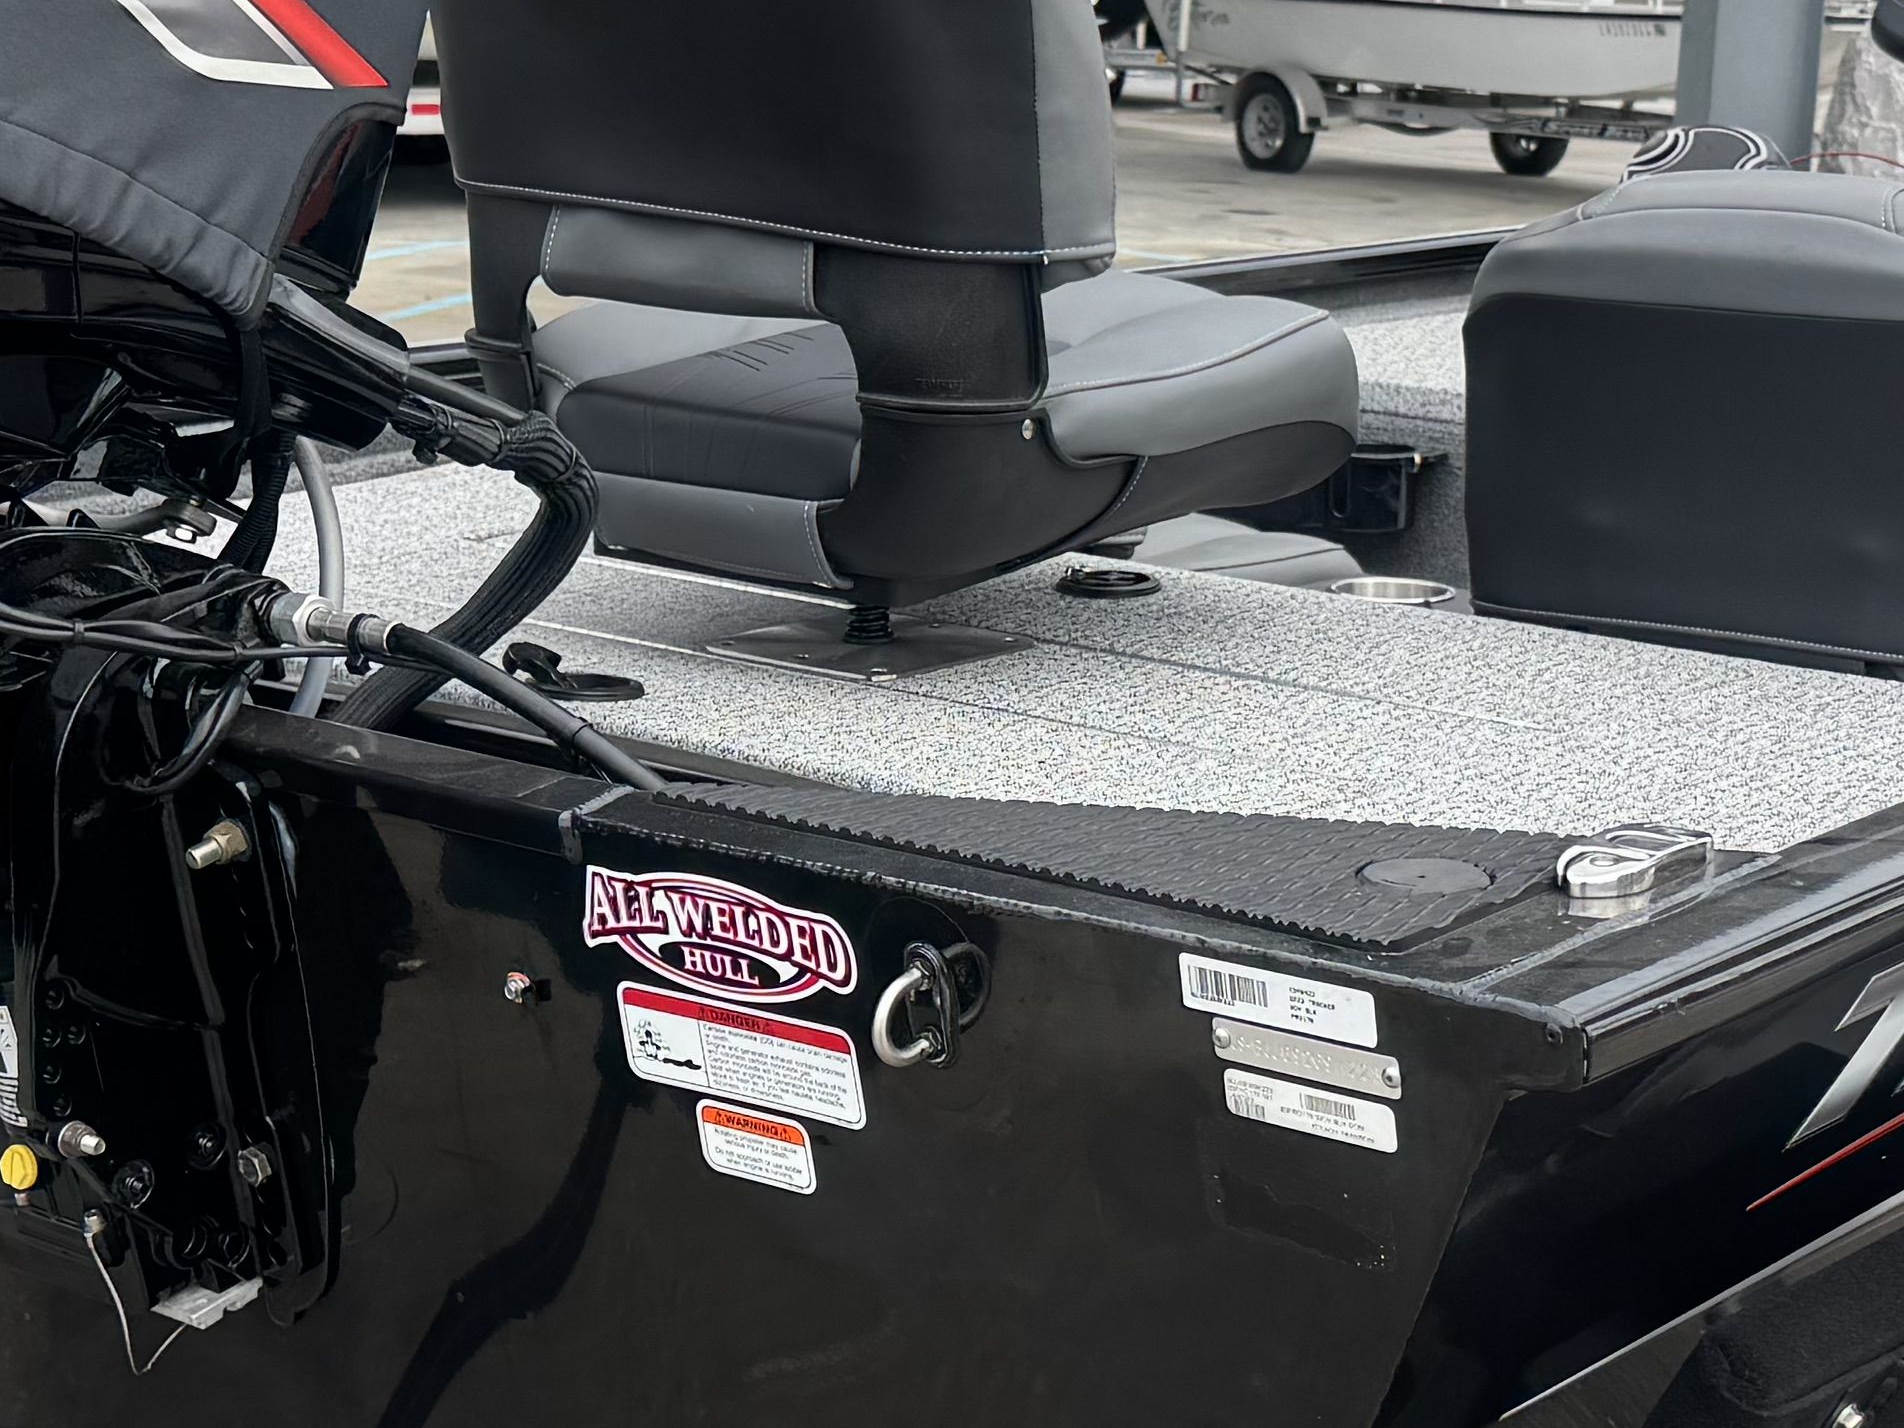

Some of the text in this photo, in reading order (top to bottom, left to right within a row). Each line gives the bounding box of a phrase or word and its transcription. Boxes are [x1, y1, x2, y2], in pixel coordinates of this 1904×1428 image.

[590, 873, 850, 983] ALL WELDED
[682, 944, 760, 986] HULL
